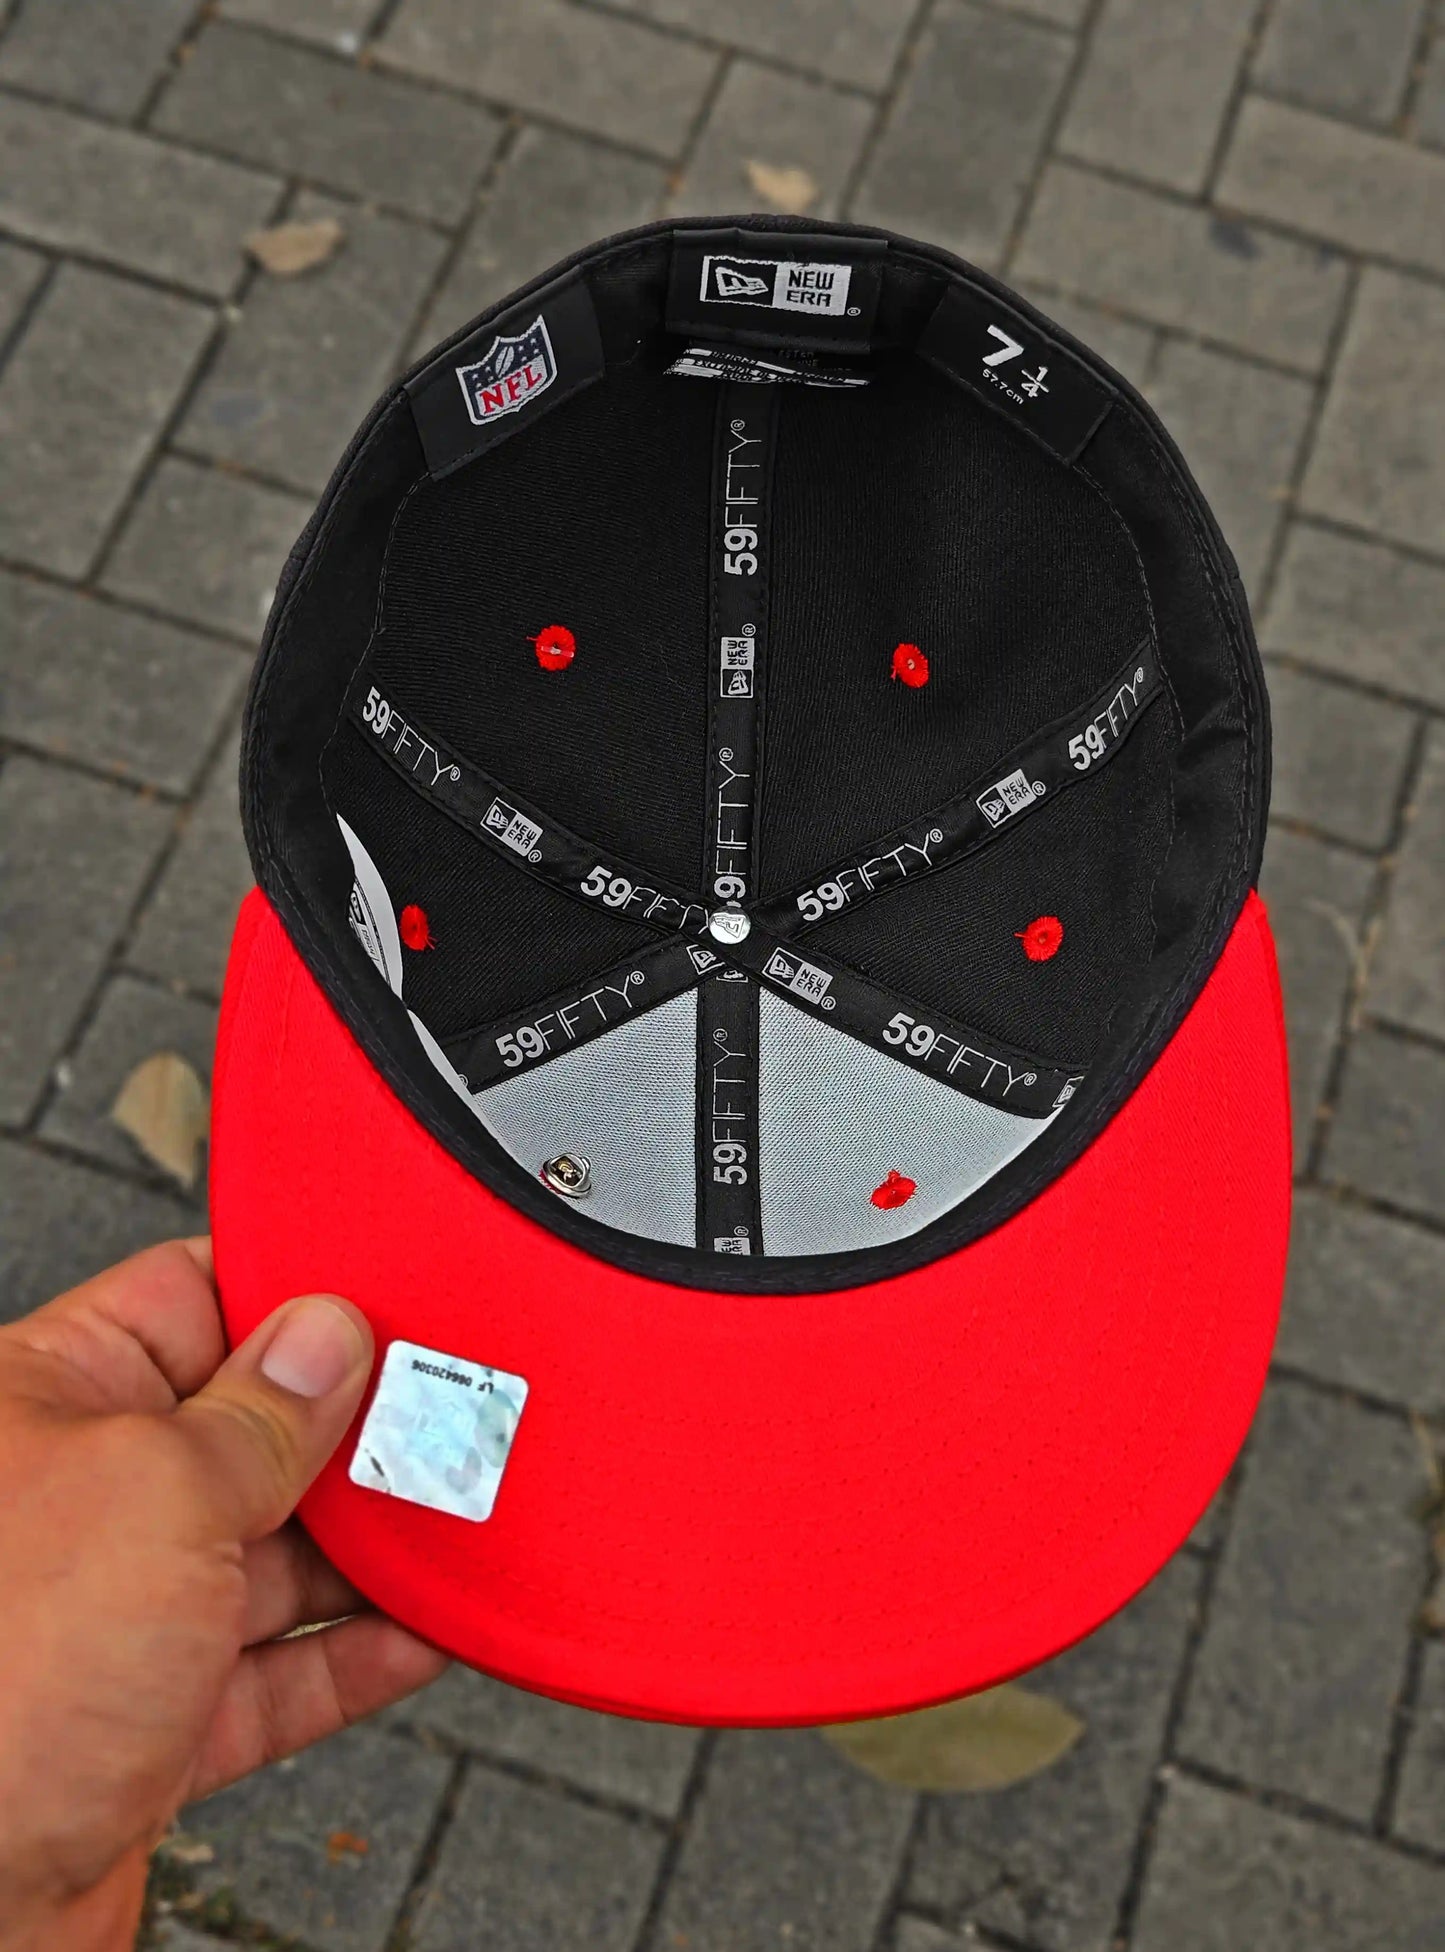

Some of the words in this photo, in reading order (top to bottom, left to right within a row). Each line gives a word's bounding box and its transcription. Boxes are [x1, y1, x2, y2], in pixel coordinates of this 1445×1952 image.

[788, 269, 835, 290] NEW
[786, 290, 832, 307] ERA
[982, 324, 1024, 367] 7
[480, 365, 542, 414] NFL
[982, 368, 1025, 404] 57.7cm
[728, 639, 738, 666] NEW
[738, 639, 749, 666] ERA
[1002, 776, 1025, 796] NEW
[1008, 787, 1031, 805] ERA
[507, 829, 532, 849] ERA
[512, 819, 537, 840] NEW
[796, 979, 822, 997] ERA
[801, 968, 827, 988] NEW
[721, 1239, 731, 1252] EW
[732, 1239, 743, 1255] RA
